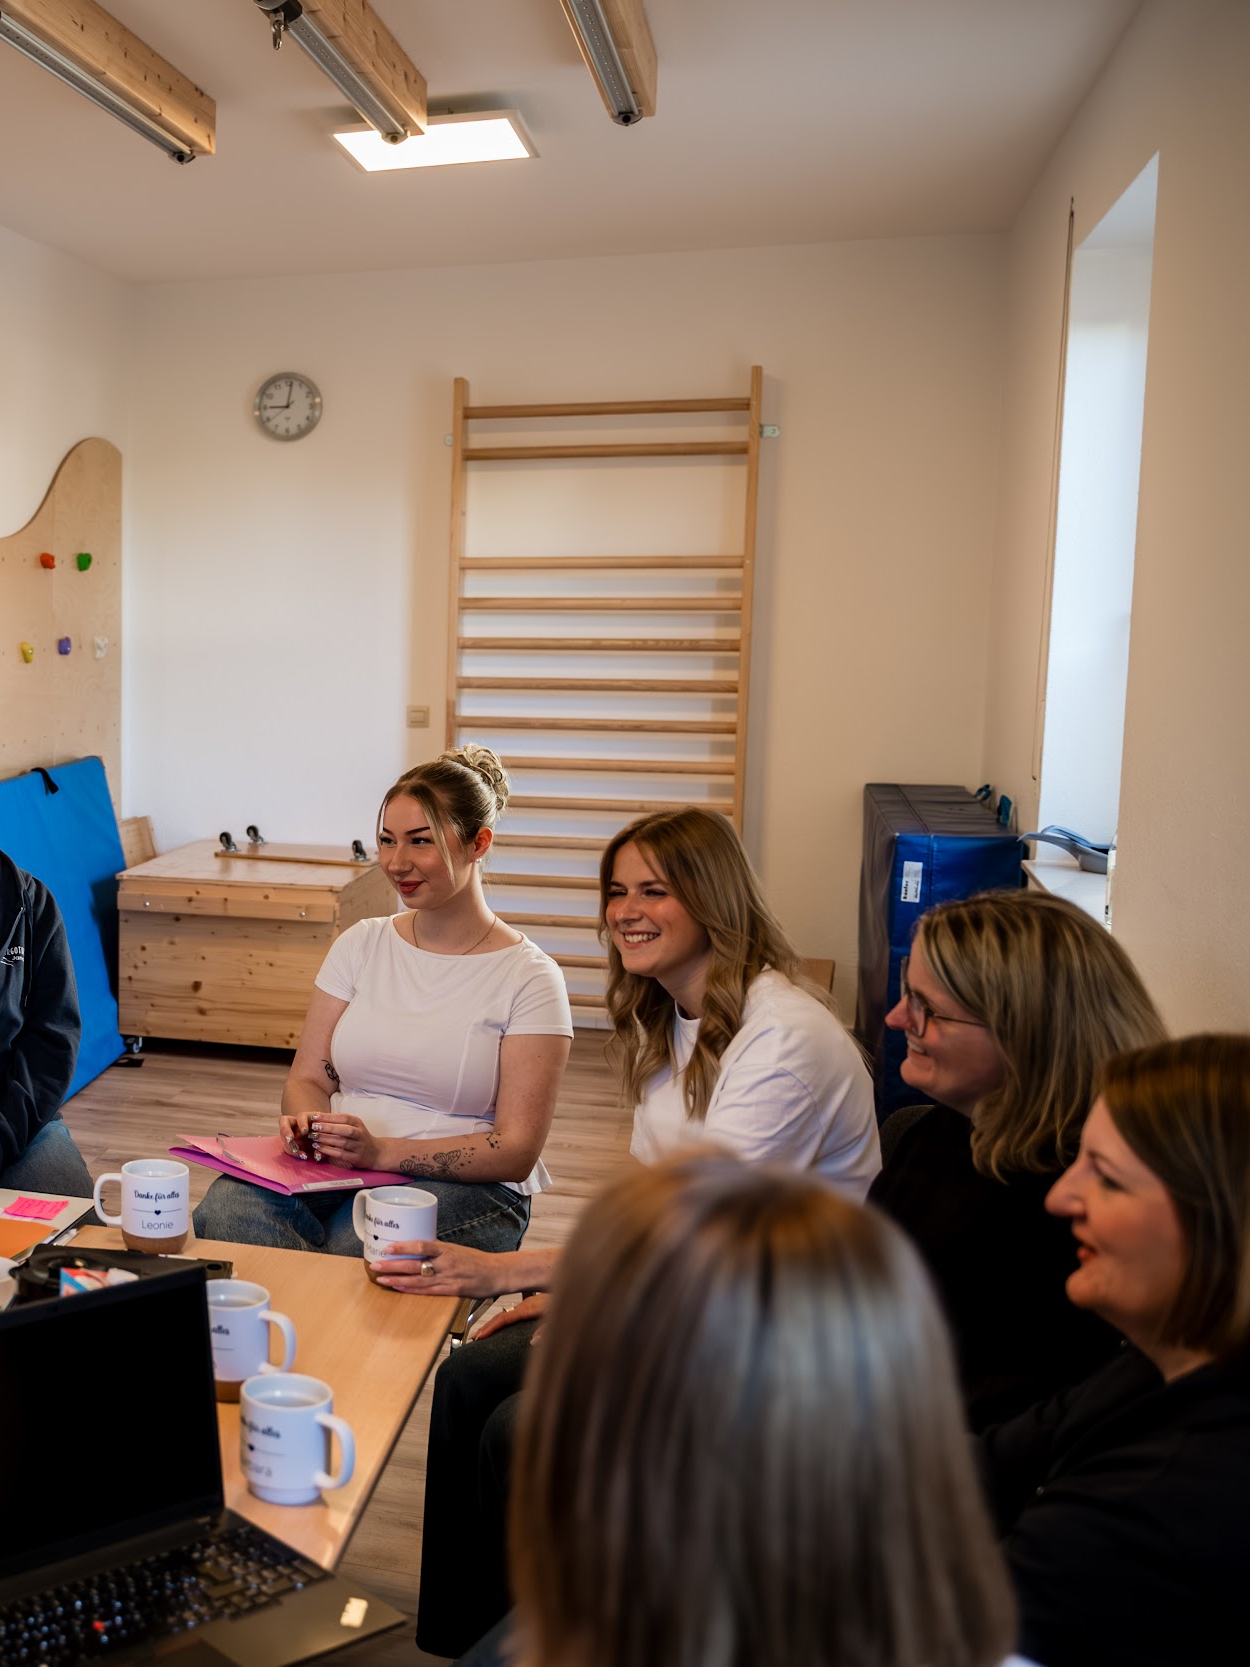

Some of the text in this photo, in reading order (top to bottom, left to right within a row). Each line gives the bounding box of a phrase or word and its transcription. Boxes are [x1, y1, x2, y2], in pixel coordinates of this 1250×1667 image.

[134, 1189, 180, 1203] Danke für alles
[141, 1219, 174, 1230] Leonie
[373, 1217, 383, 1228] für
[383, 1219, 400, 1230] alles
